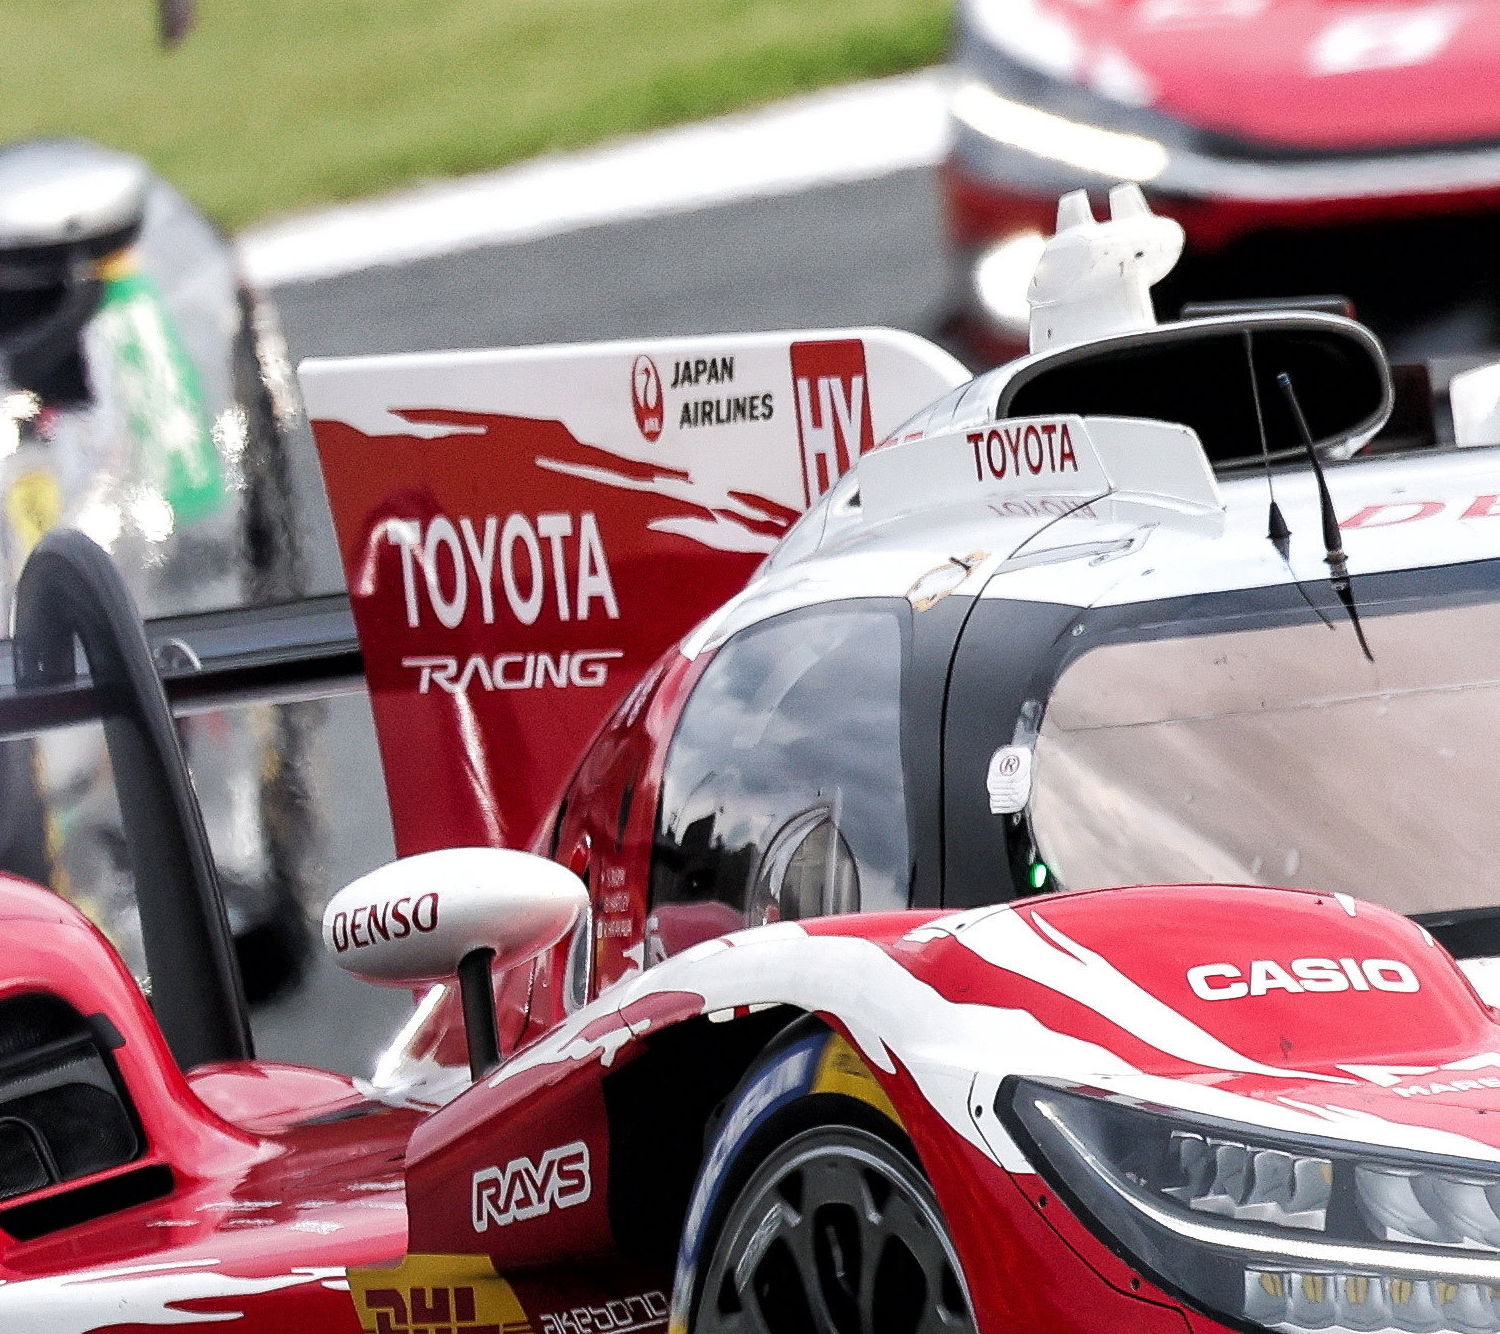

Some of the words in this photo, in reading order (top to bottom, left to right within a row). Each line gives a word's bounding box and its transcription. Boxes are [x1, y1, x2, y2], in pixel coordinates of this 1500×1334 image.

[671, 356, 735, 389] JAPAN
[679, 393, 774, 430] AIRLINES
[797, 376, 864, 507] HY
[966, 423, 1079, 482] TOYOTA
[389, 512, 620, 630] TOYOTA
[401, 649, 625, 695] RACING
[332, 892, 439, 953] DENSO
[1186, 957, 1422, 1001] CASIO
[471, 1139, 592, 1233] RAYS
